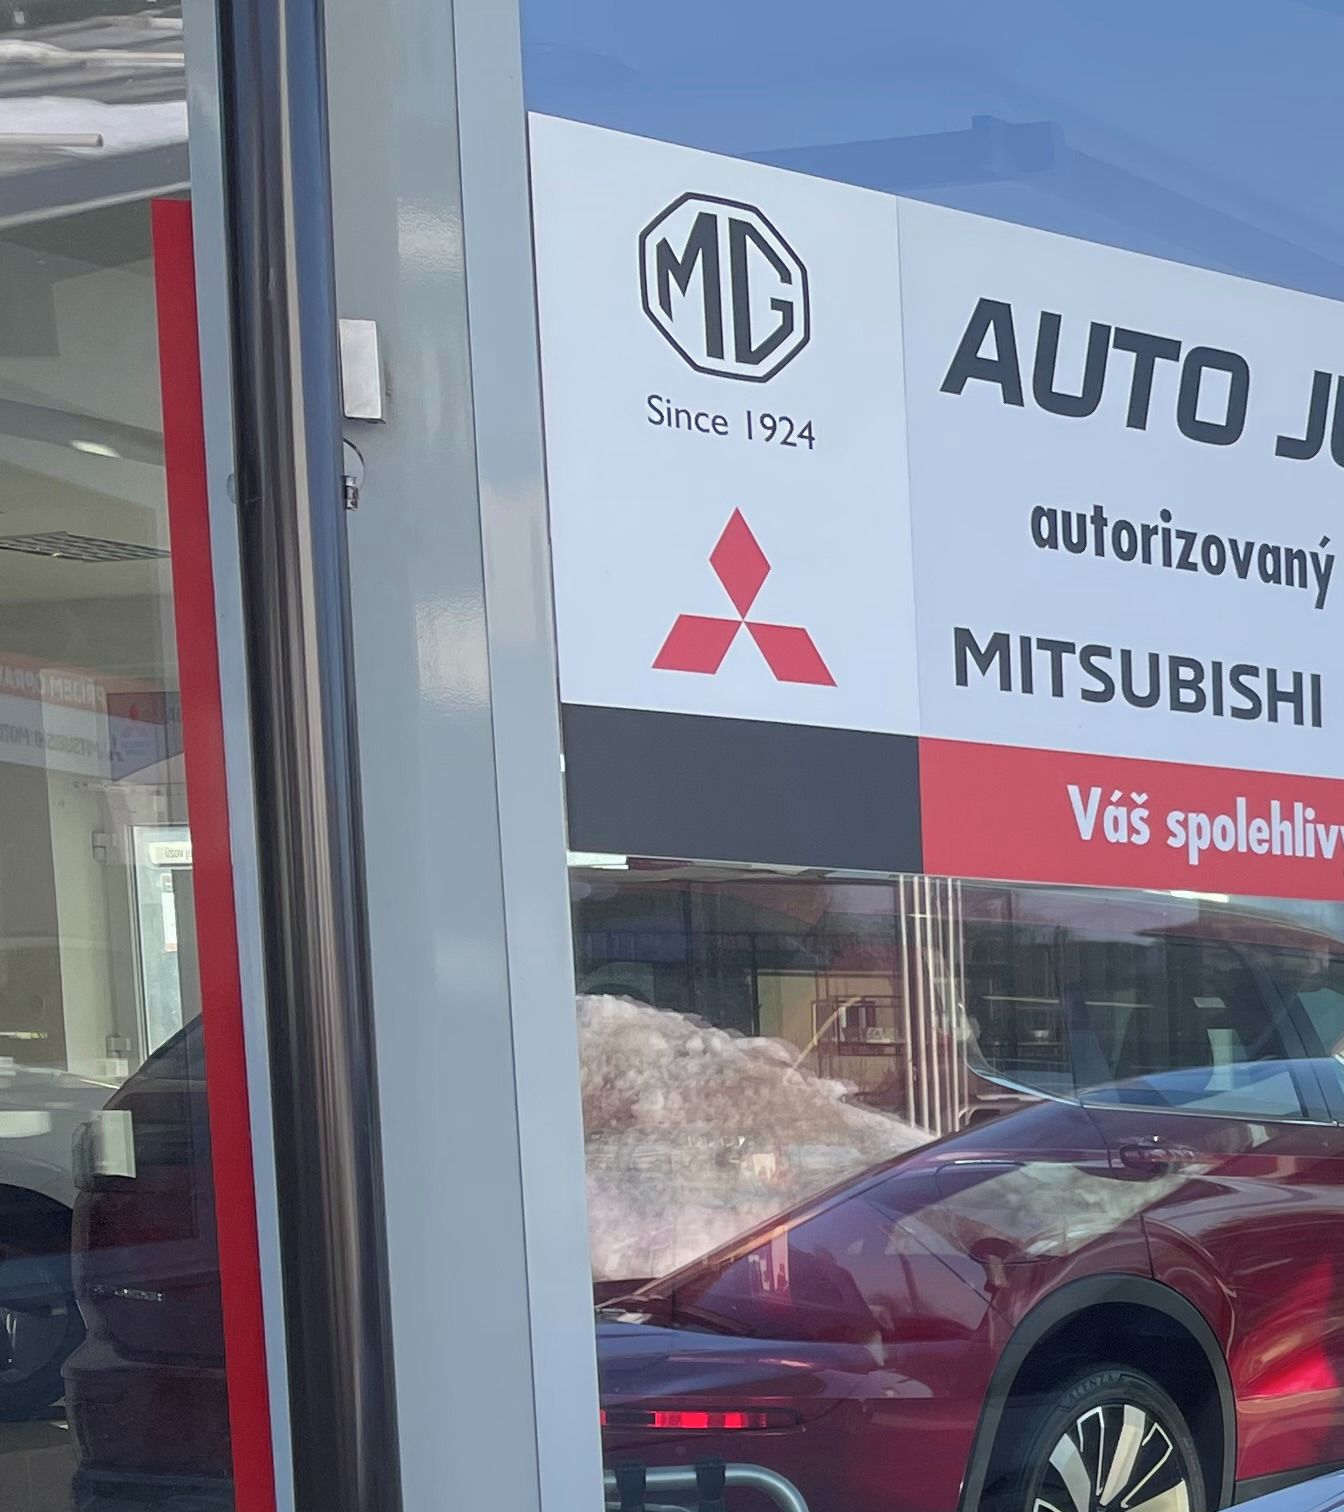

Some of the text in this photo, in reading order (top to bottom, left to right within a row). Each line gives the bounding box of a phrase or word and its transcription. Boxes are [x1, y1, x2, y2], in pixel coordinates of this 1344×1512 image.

[656, 210, 796, 367] MG
[647, 394, 816, 450] Since 1924
[939, 297, 1250, 446] AUTO
[1030, 503, 1335, 610] autorizovaný
[953, 626, 1322, 729] MITSUBISHI
[1066, 783, 1151, 846] Váš
